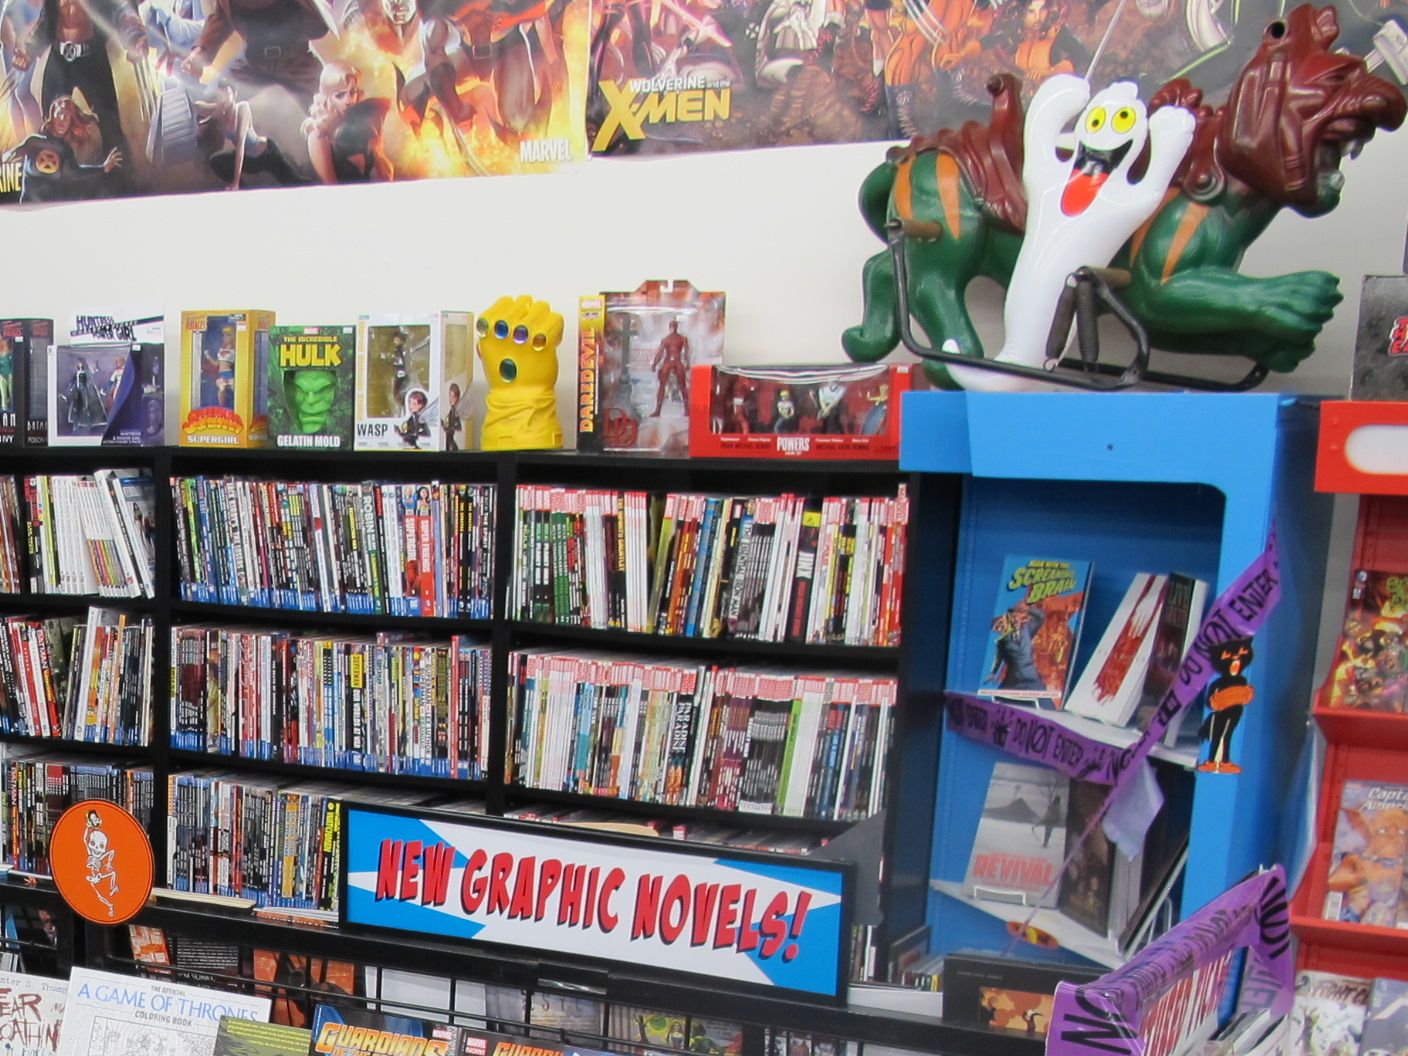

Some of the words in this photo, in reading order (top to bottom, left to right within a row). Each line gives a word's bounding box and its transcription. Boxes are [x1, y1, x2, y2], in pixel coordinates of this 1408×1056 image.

[630, 77, 706, 93] WOLVERINE
[520, 139, 571, 162] MARVEL
[280, 344, 342, 367] HULK
[580, 327, 596, 432] DAREDEVIL
[2, 434, 14, 443] IVY
[187, 434, 239, 445] SUPERGIRL
[277, 435, 314, 447] GELATIN
[315, 436, 341, 448] MOLD
[357, 424, 388, 437] WASP
[777, 437, 810, 451] POWERS
[1229, 569, 1279, 622] ENTER
[1052, 733, 1084, 769] ENTER
[972, 853, 1055, 887] REVIVAL
[375, 836, 455, 907] NEW
[461, 847, 625, 933] GRAPHIC
[632, 872, 814, 963] NOVELS!
[77, 982, 92, 998] A
[95, 985, 146, 1010] GAME
[149, 994, 173, 1011] OF
[163, 986, 186, 996] OFFICIAL
[135, 1010, 171, 1023] COLORING
[173, 1016, 194, 1028] BOOK
[1061, 982, 1139, 1056] NO
